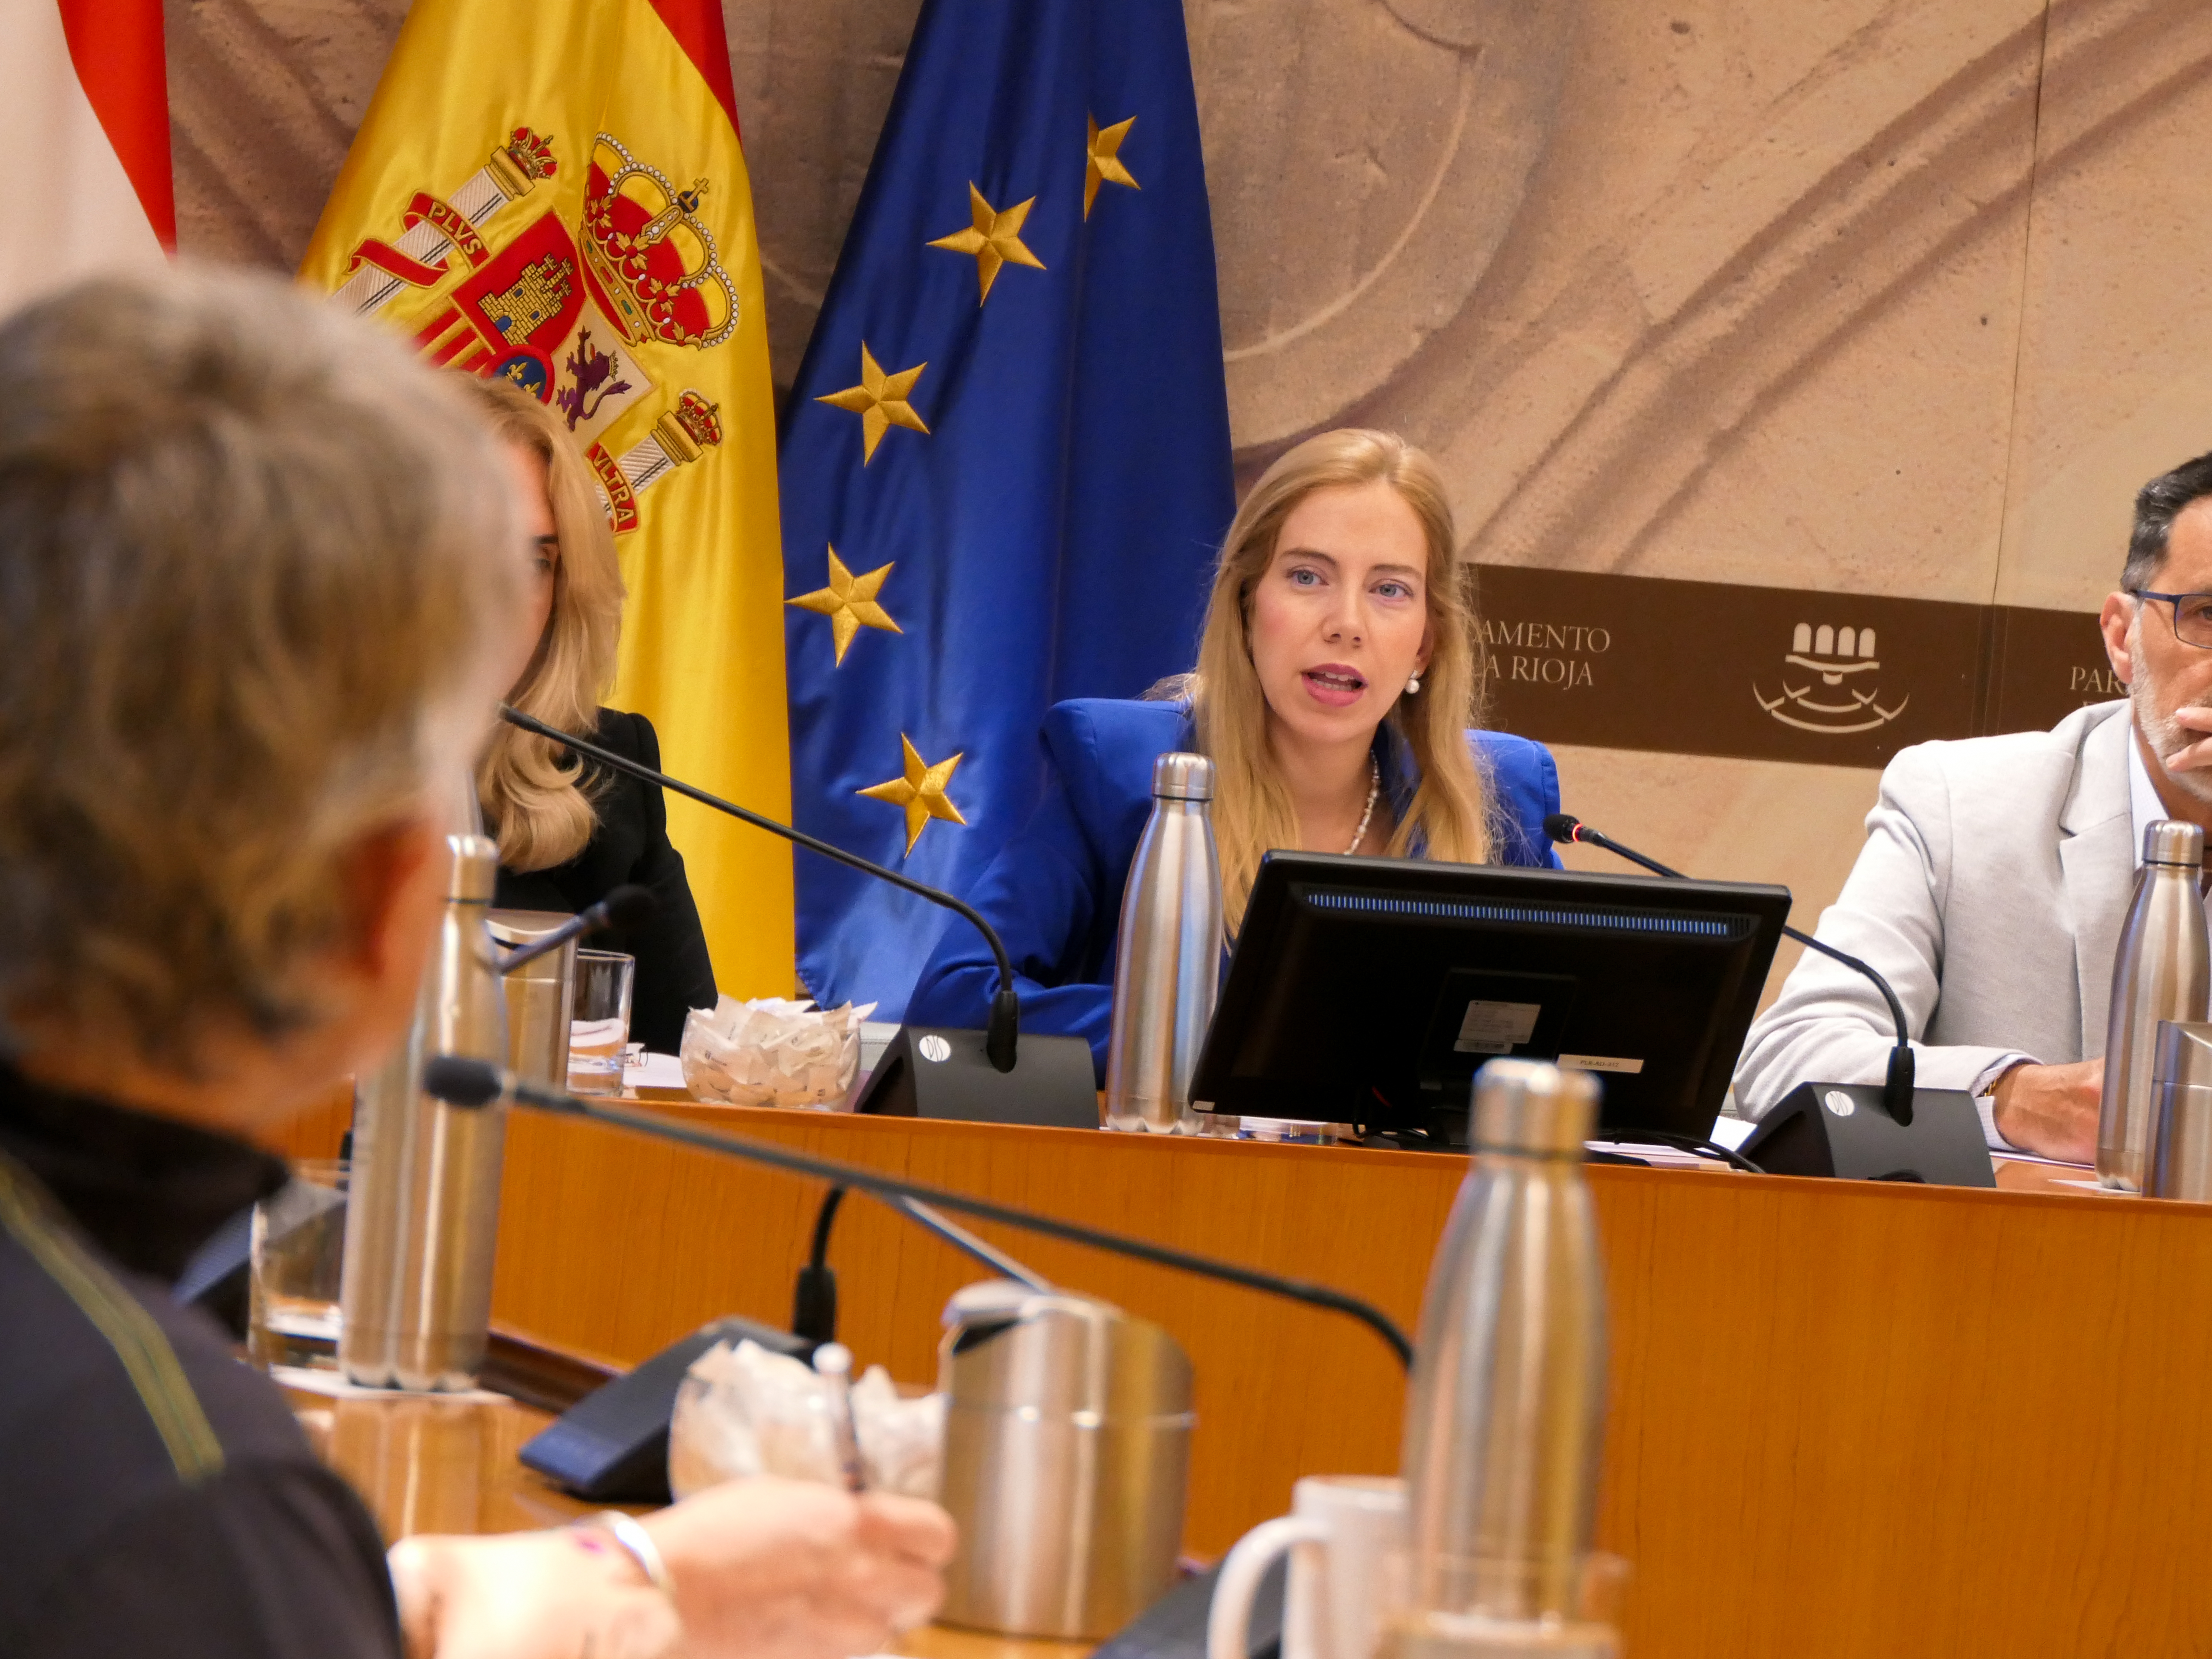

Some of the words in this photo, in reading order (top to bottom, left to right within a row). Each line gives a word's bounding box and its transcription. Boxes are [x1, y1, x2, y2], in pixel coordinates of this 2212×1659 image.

[427, 200, 482, 255] PLVS
[594, 447, 635, 523] VLTRA
[1477, 619, 1610, 653] AMENTO
[1512, 655, 1594, 690] RIOJA
